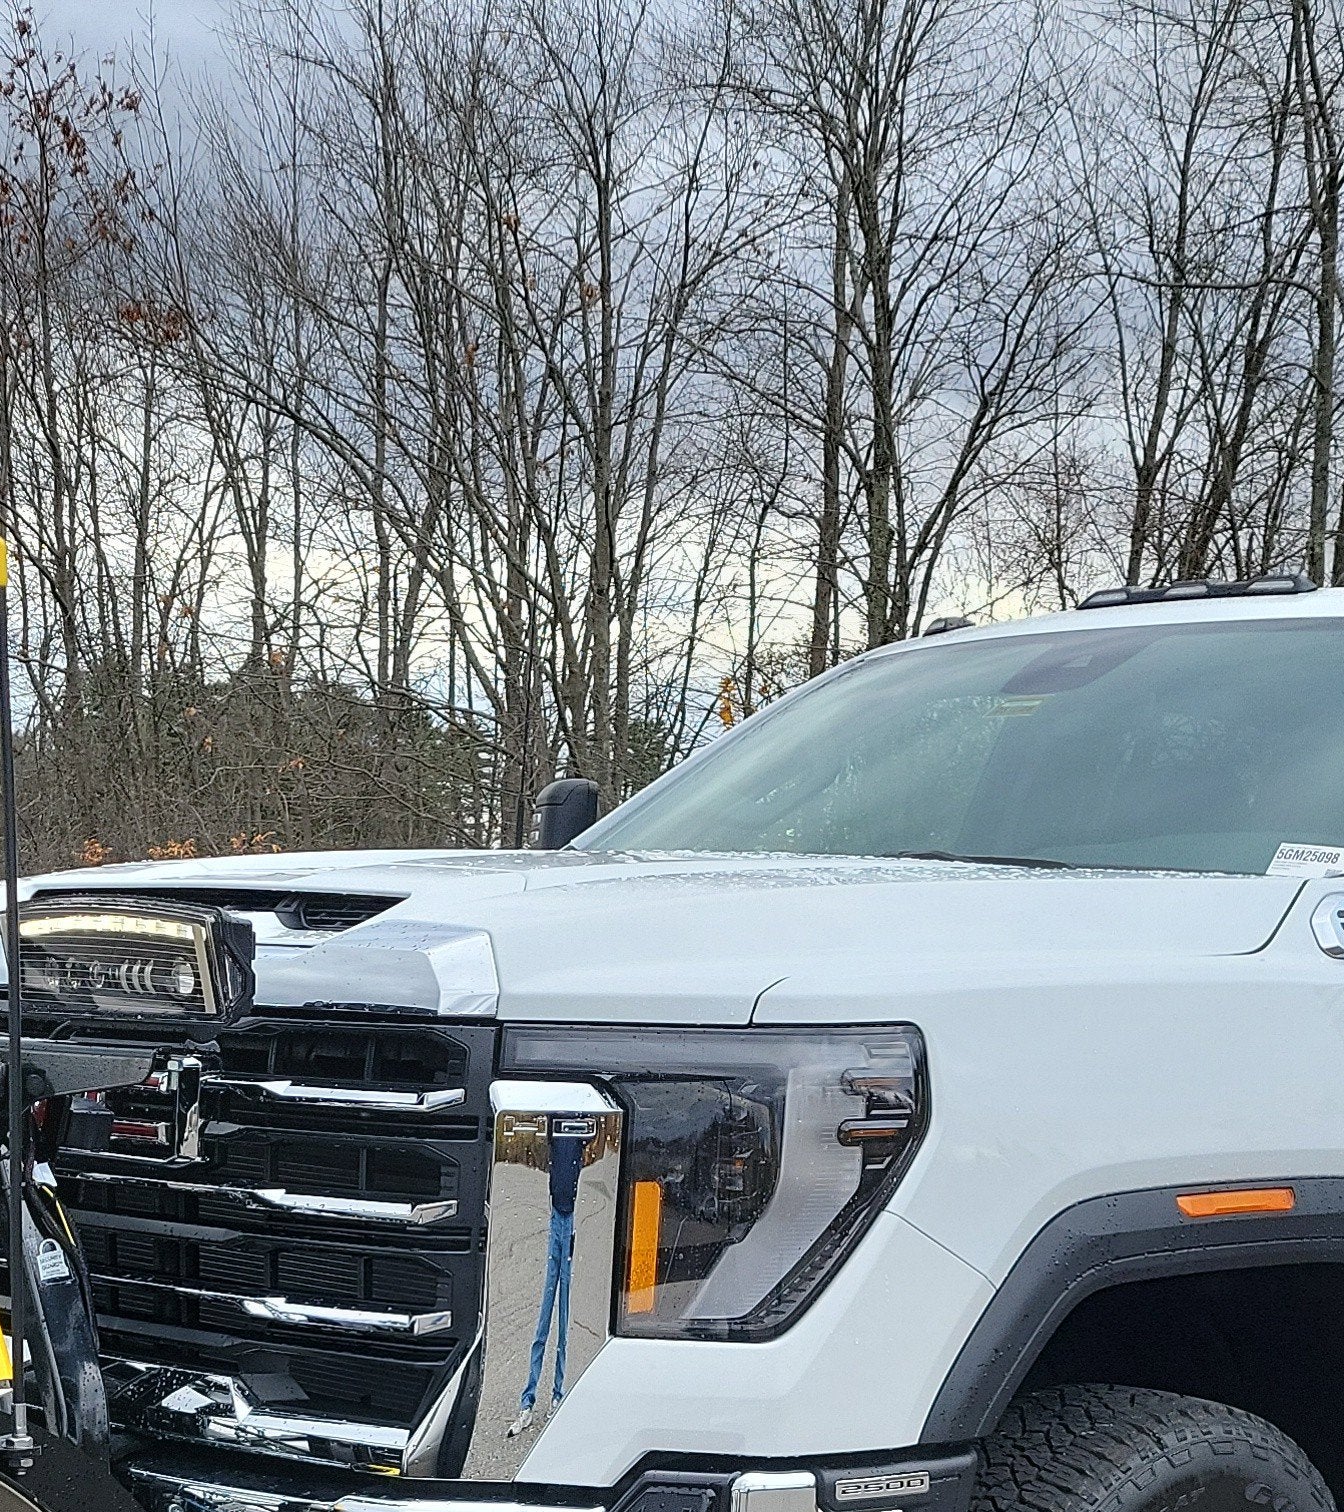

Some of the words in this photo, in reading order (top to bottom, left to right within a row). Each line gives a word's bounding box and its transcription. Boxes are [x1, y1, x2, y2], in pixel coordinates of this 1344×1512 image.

[1277, 848, 1340, 865] 5GM25098
[503, 1115, 597, 1137] HD
[841, 1478, 925, 1495] 2500
